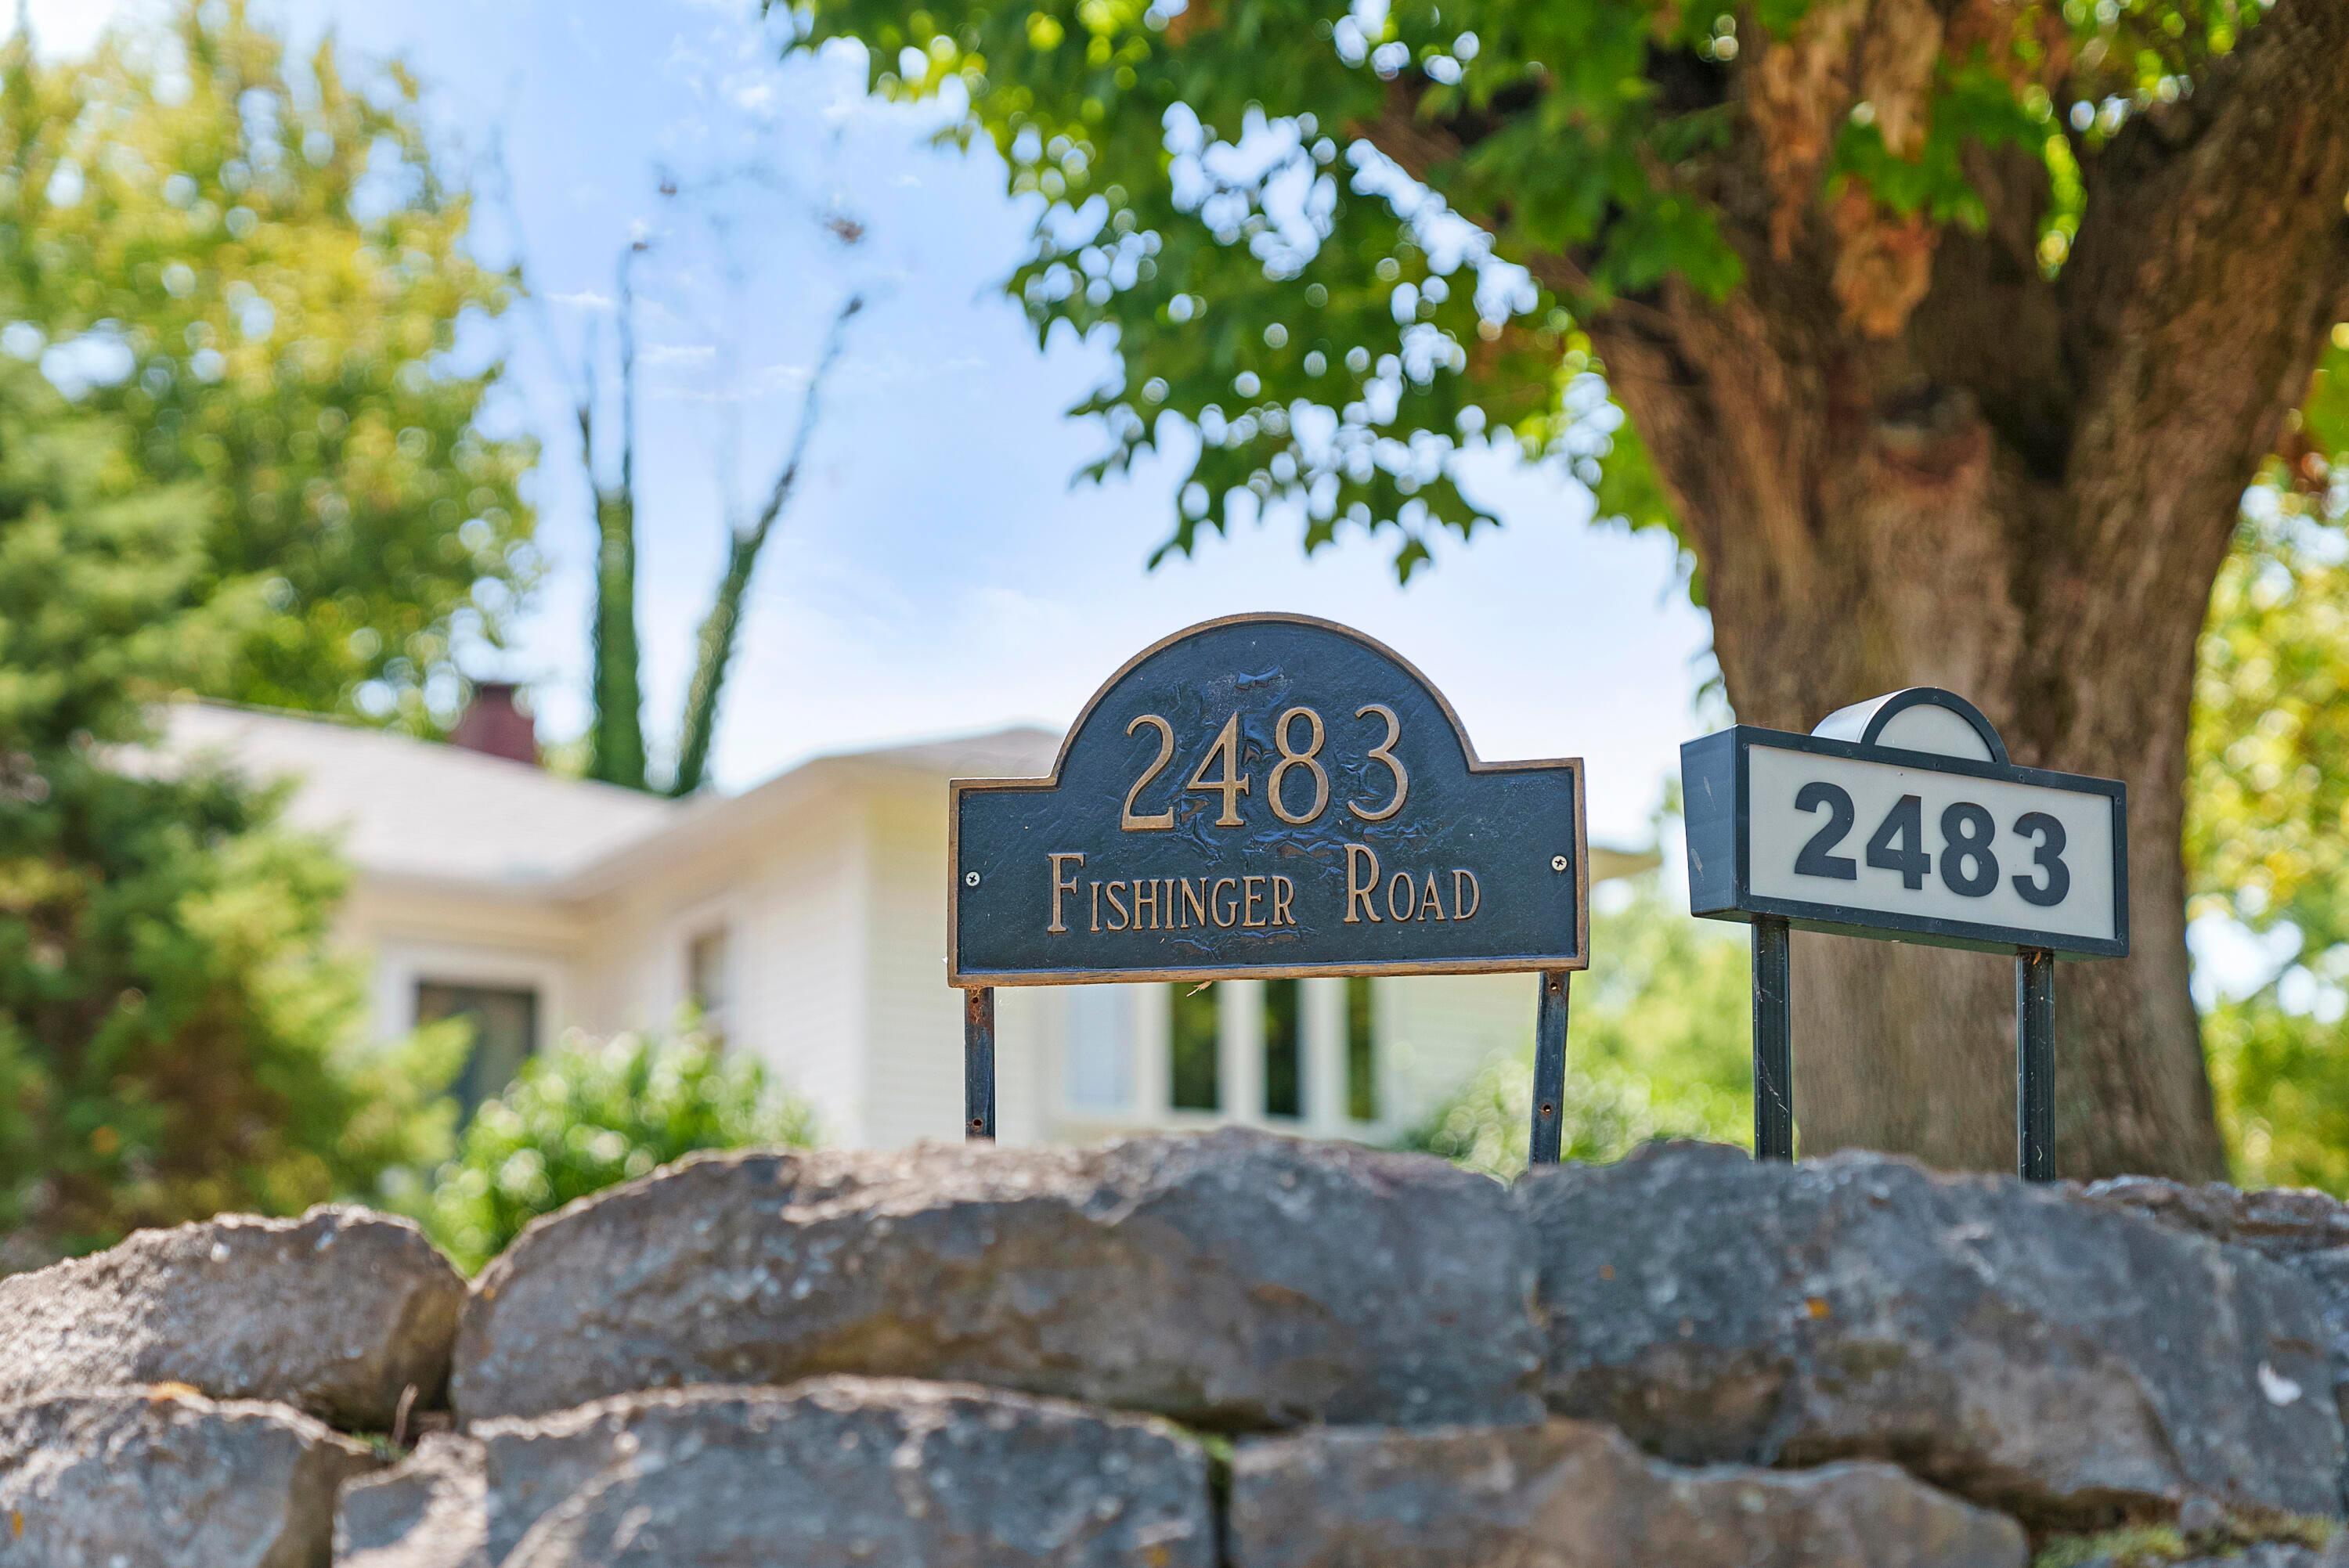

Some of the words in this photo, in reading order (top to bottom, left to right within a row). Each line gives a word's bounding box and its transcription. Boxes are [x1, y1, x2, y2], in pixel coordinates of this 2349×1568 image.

[1120, 704, 1409, 831] 2483
[1048, 852, 1297, 933] FISHINGER
[1344, 843, 1481, 923] ROAD
[1795, 781, 2071, 907] 2483
